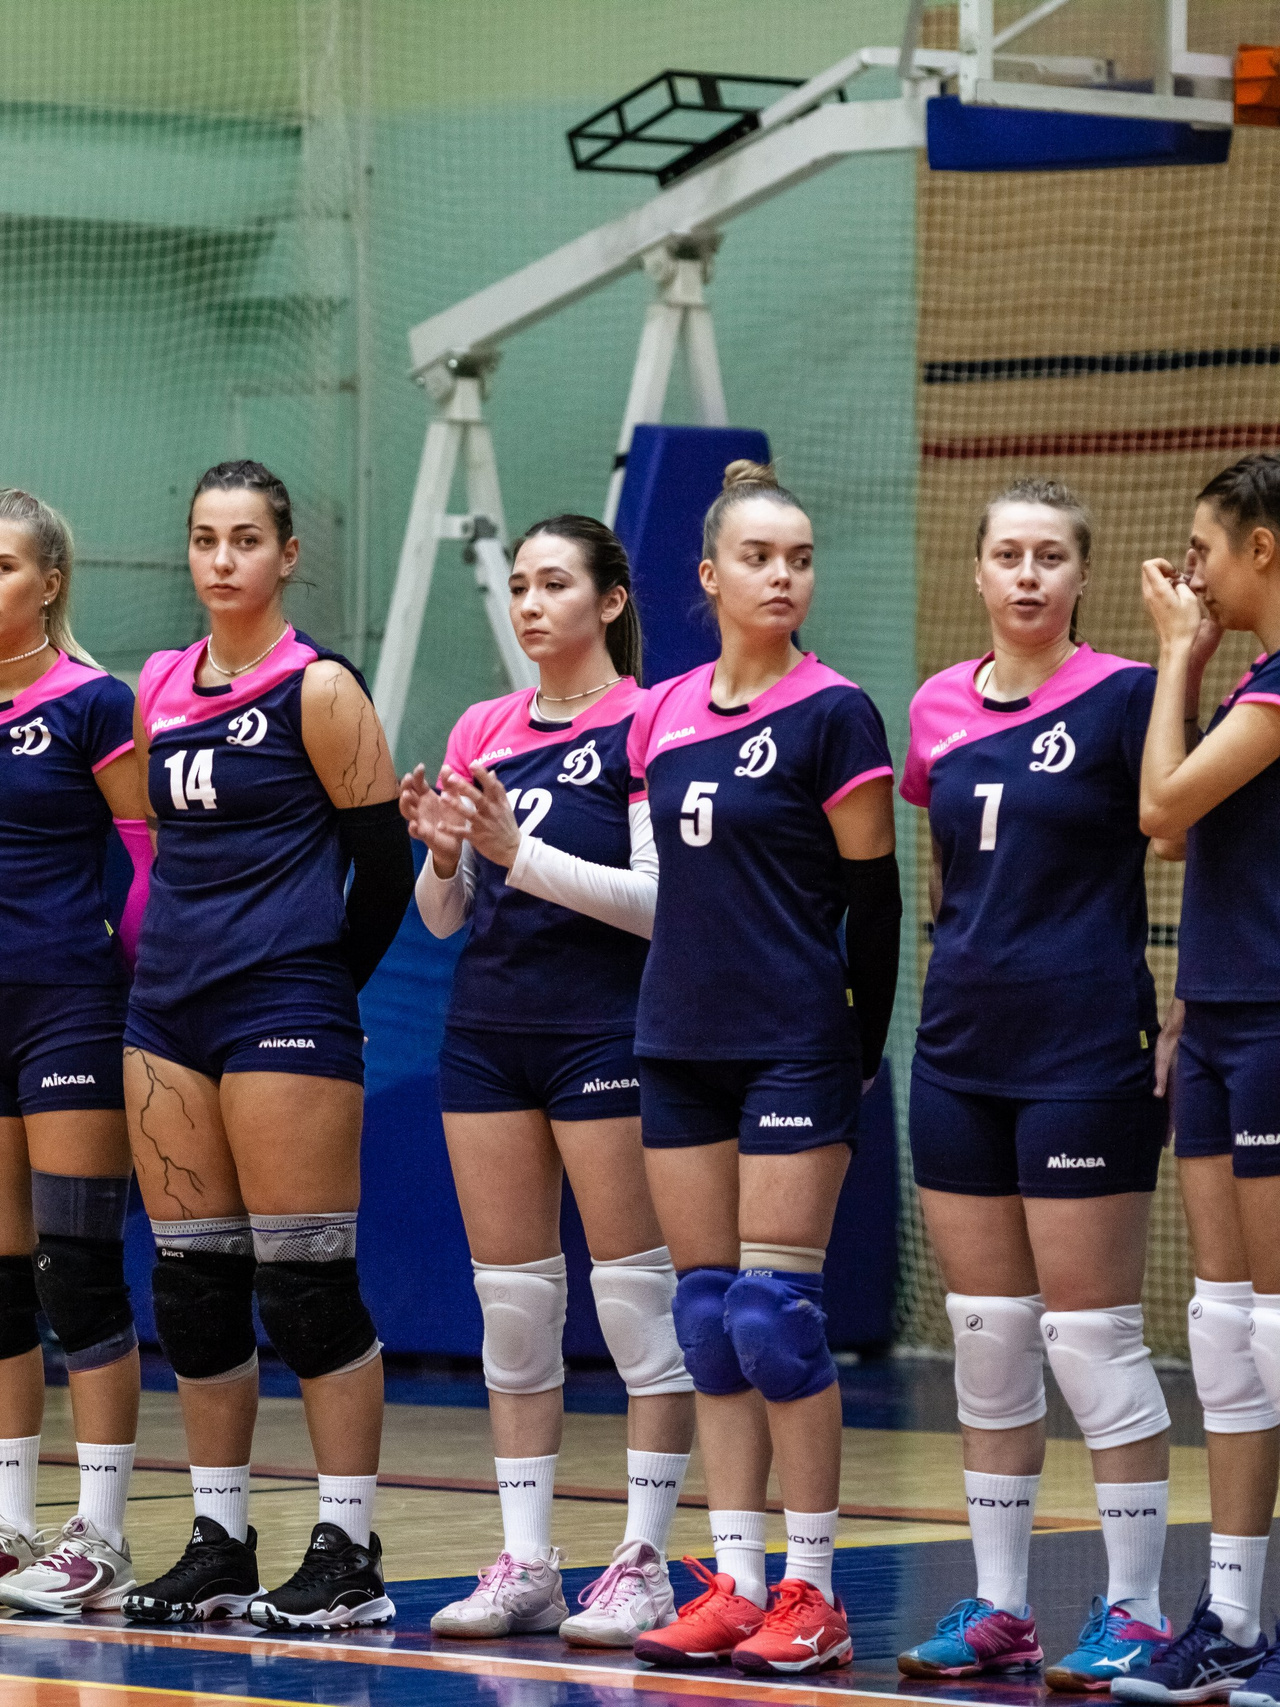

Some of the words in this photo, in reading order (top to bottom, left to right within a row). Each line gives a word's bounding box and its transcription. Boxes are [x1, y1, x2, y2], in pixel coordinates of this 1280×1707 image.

[164, 749, 217, 810] 14
[680, 781, 719, 847] 5
[974, 783, 1004, 850] 7
